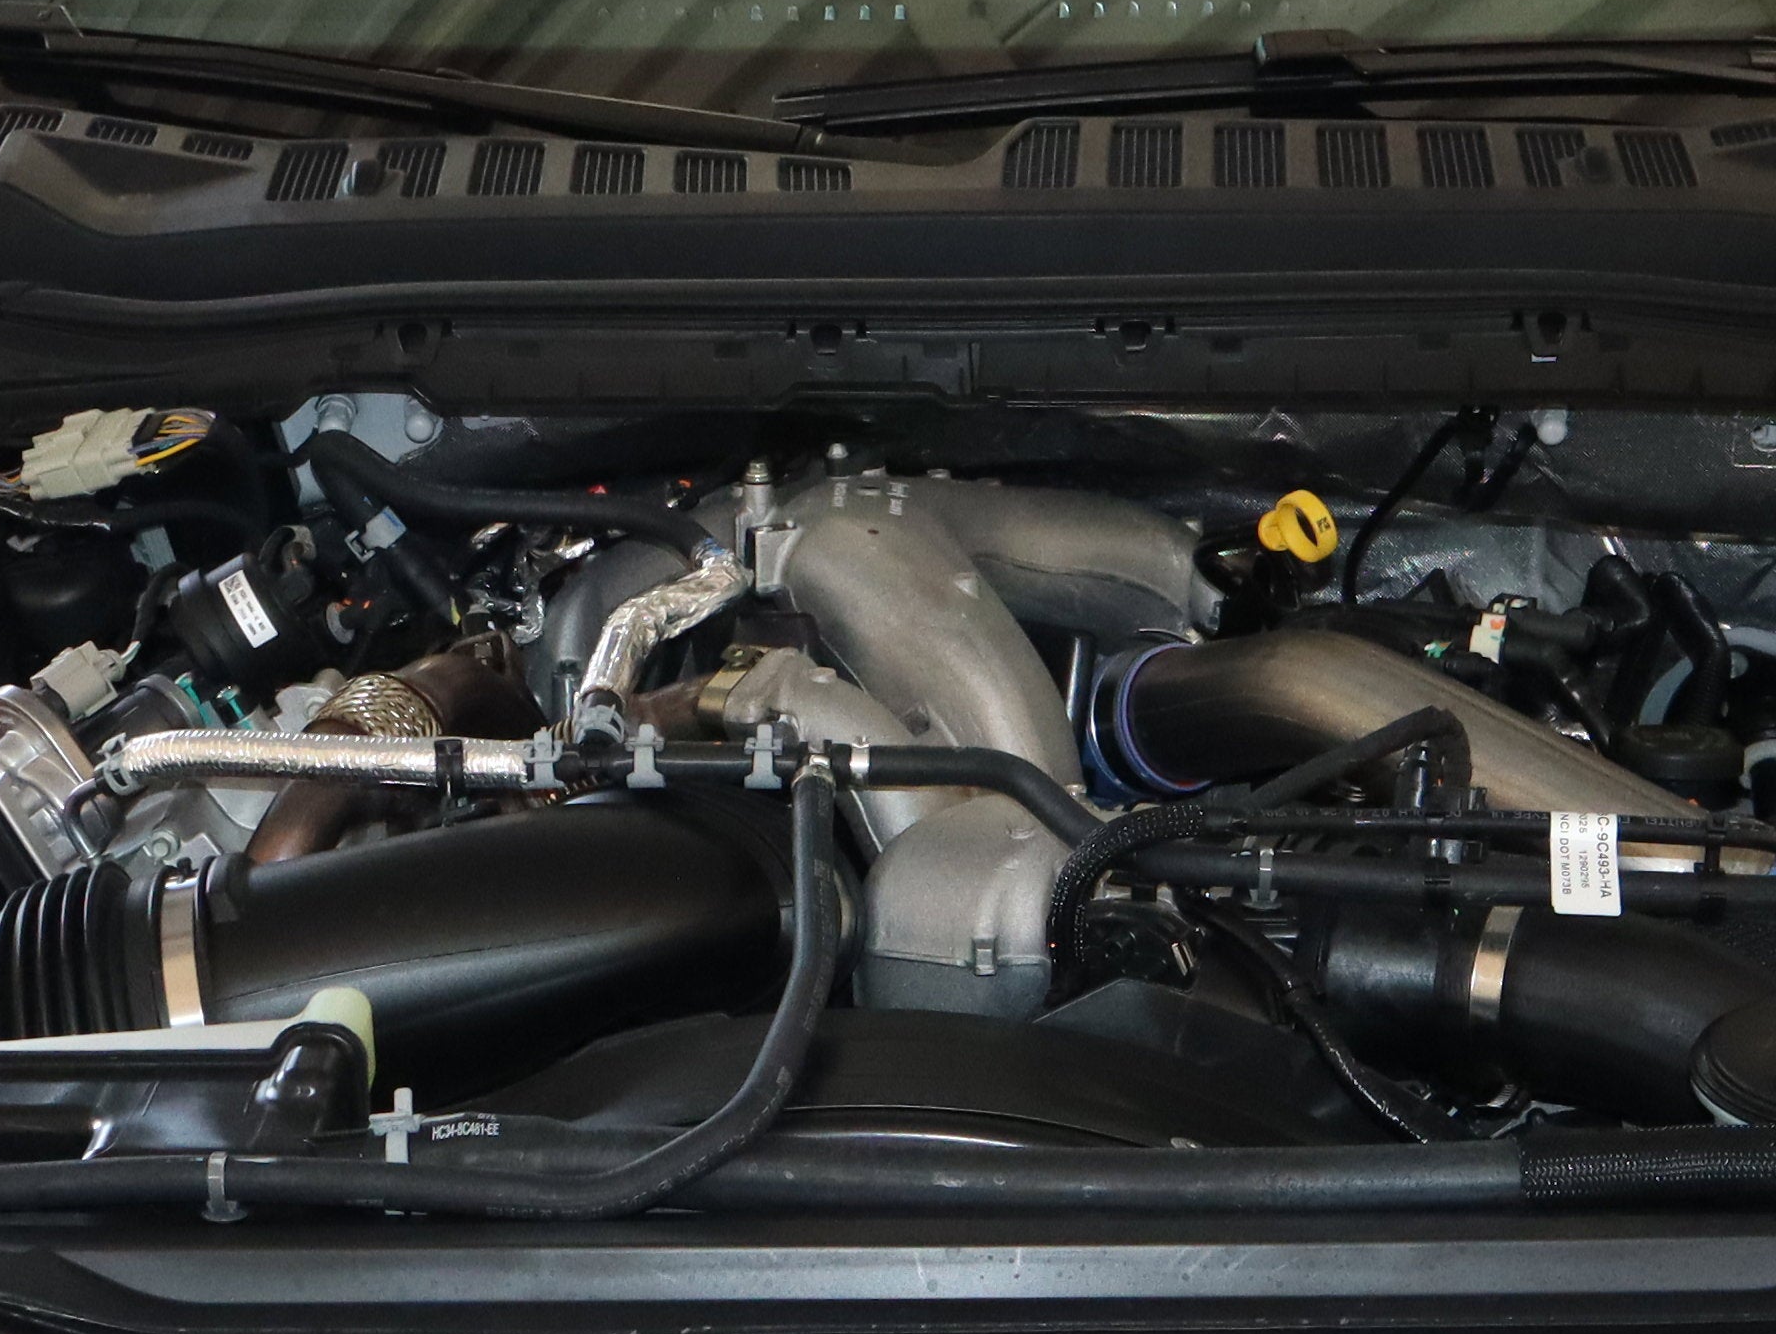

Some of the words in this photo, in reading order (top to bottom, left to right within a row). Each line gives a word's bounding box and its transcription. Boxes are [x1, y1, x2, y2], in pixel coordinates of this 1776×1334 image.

[1560, 838, 1570, 860] DOT
[1596, 813, 1622, 898] C-9C493-HA
[1561, 862, 1571, 895] M073B
